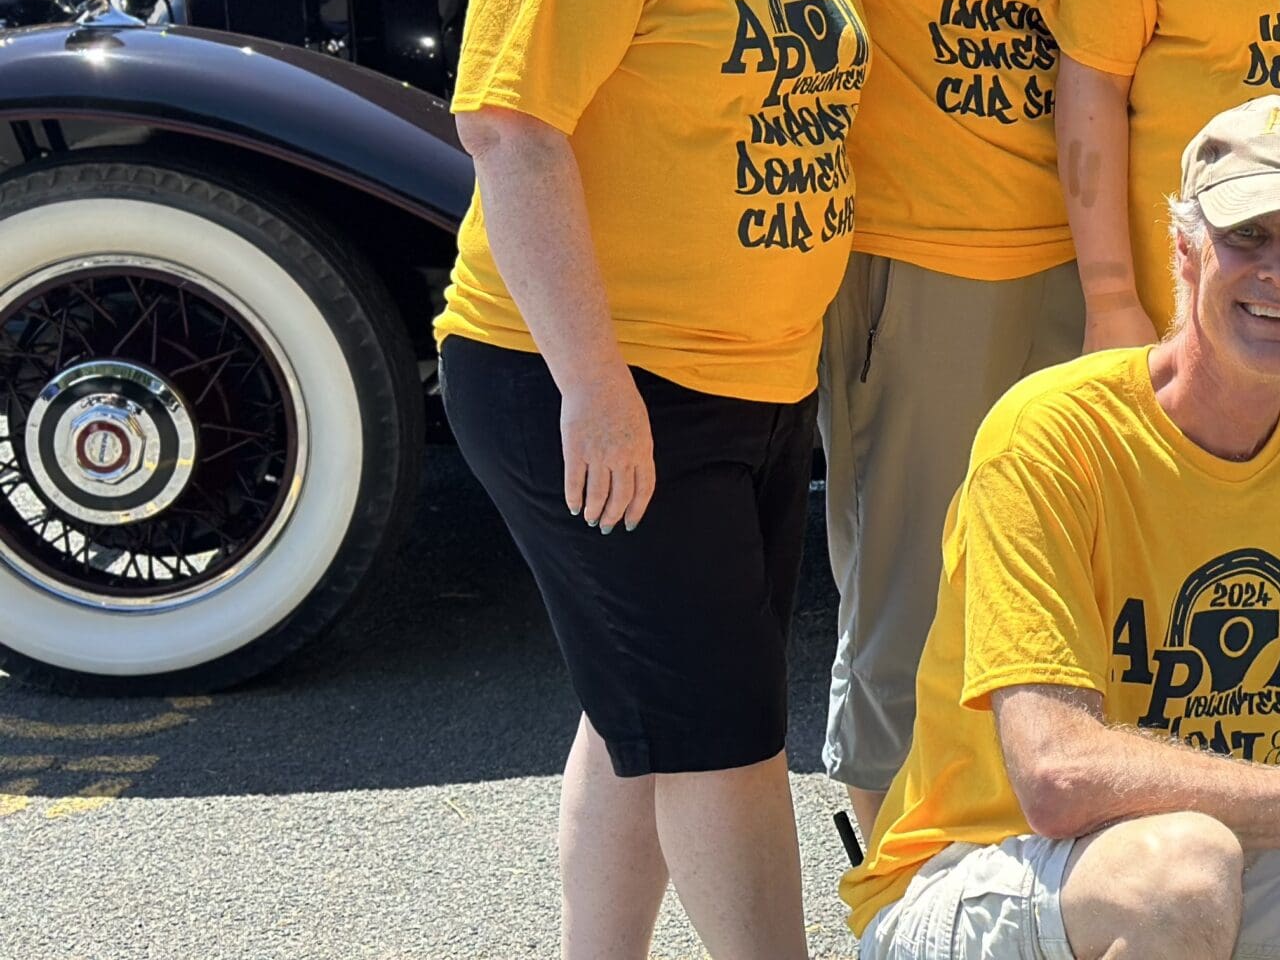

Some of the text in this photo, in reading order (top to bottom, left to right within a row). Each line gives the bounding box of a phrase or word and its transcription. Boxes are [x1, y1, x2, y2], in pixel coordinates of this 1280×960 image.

[721, 0, 806, 108] AP
[791, 66, 866, 95] VOLUNTEE
[936, 74, 1018, 124] CAR
[737, 202, 813, 253] CAR
[1210, 581, 1272, 607] 2024
